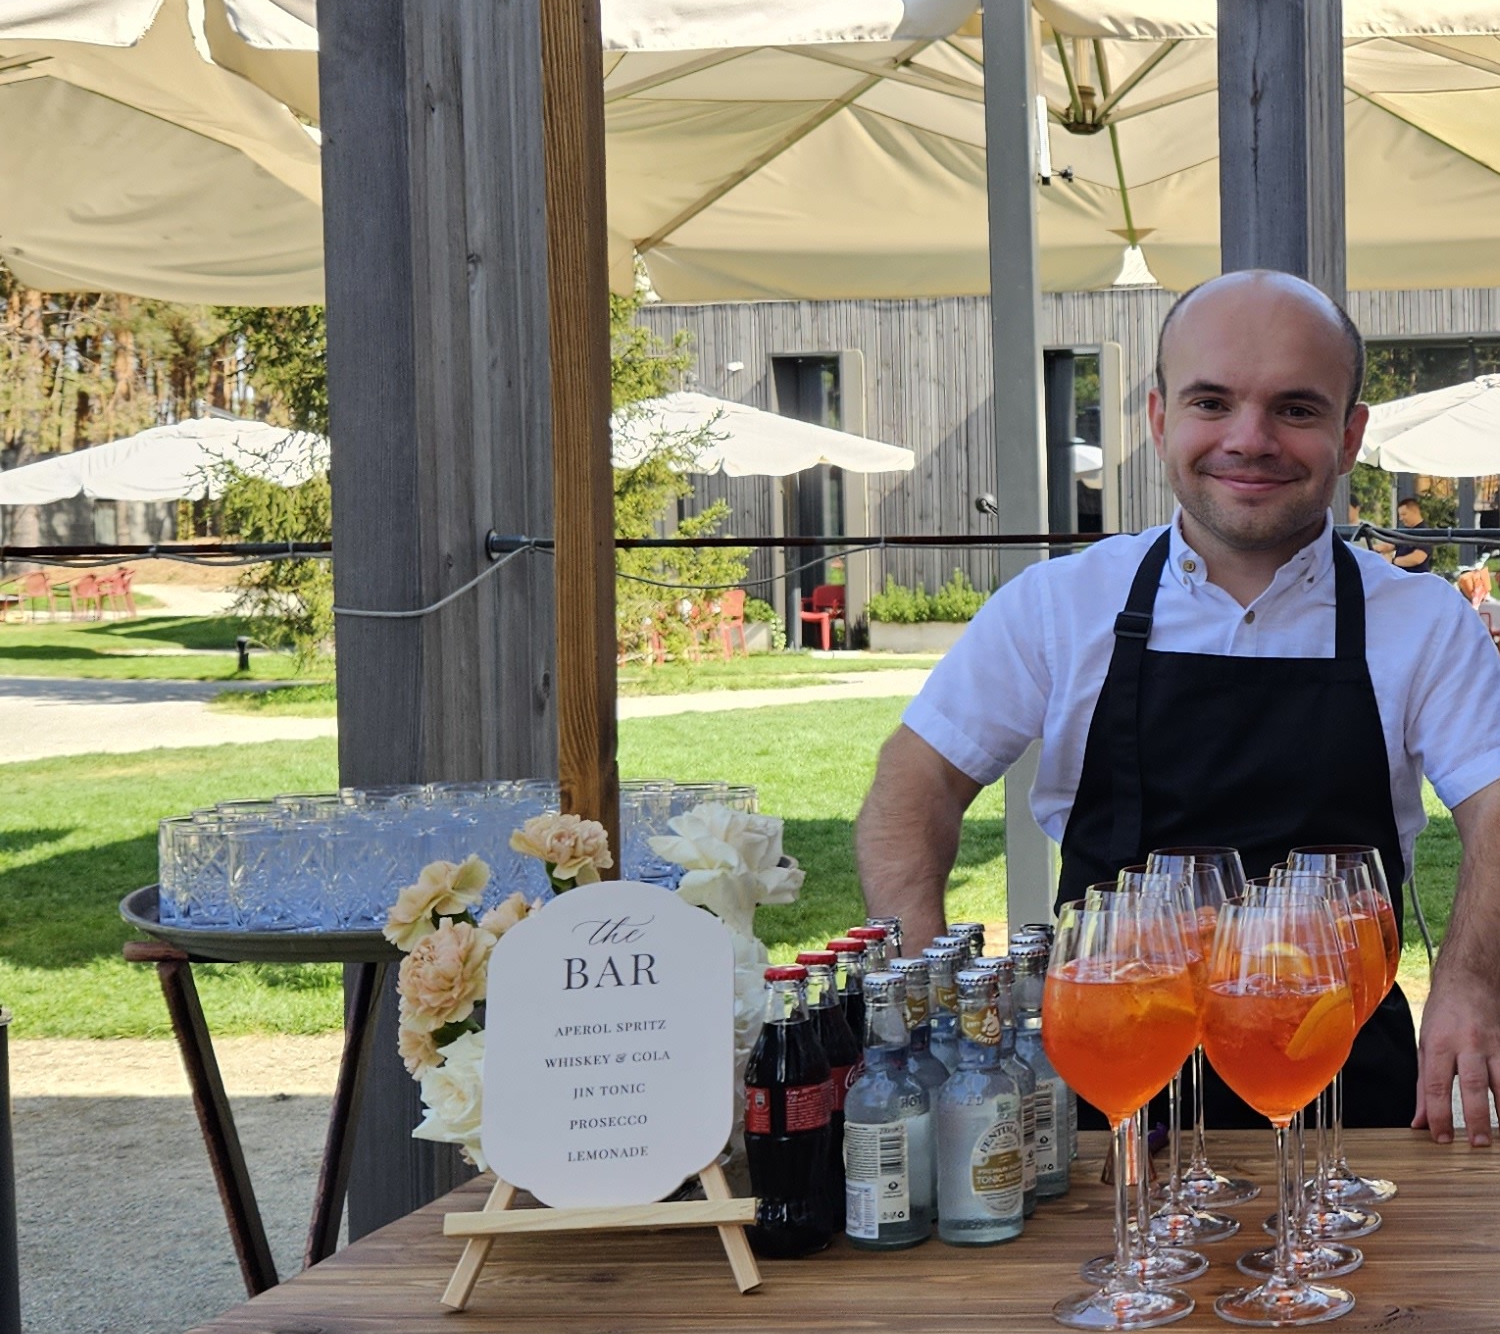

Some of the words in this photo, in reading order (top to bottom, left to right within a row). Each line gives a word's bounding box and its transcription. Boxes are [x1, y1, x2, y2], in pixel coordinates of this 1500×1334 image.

[572, 915, 655, 945] the
[563, 953, 660, 990] BAR
[554, 1023, 612, 1037] APEROL
[616, 1020, 667, 1033] SPRITZ
[545, 1054, 611, 1069] WHISKEY
[615, 1053, 627, 1064] &
[632, 1051, 671, 1063] COLA
[573, 1086, 595, 1100] JIN
[600, 1083, 646, 1097] TONIC
[569, 1115, 648, 1130] PROSECCO
[567, 1146, 649, 1162] LEMONADE
